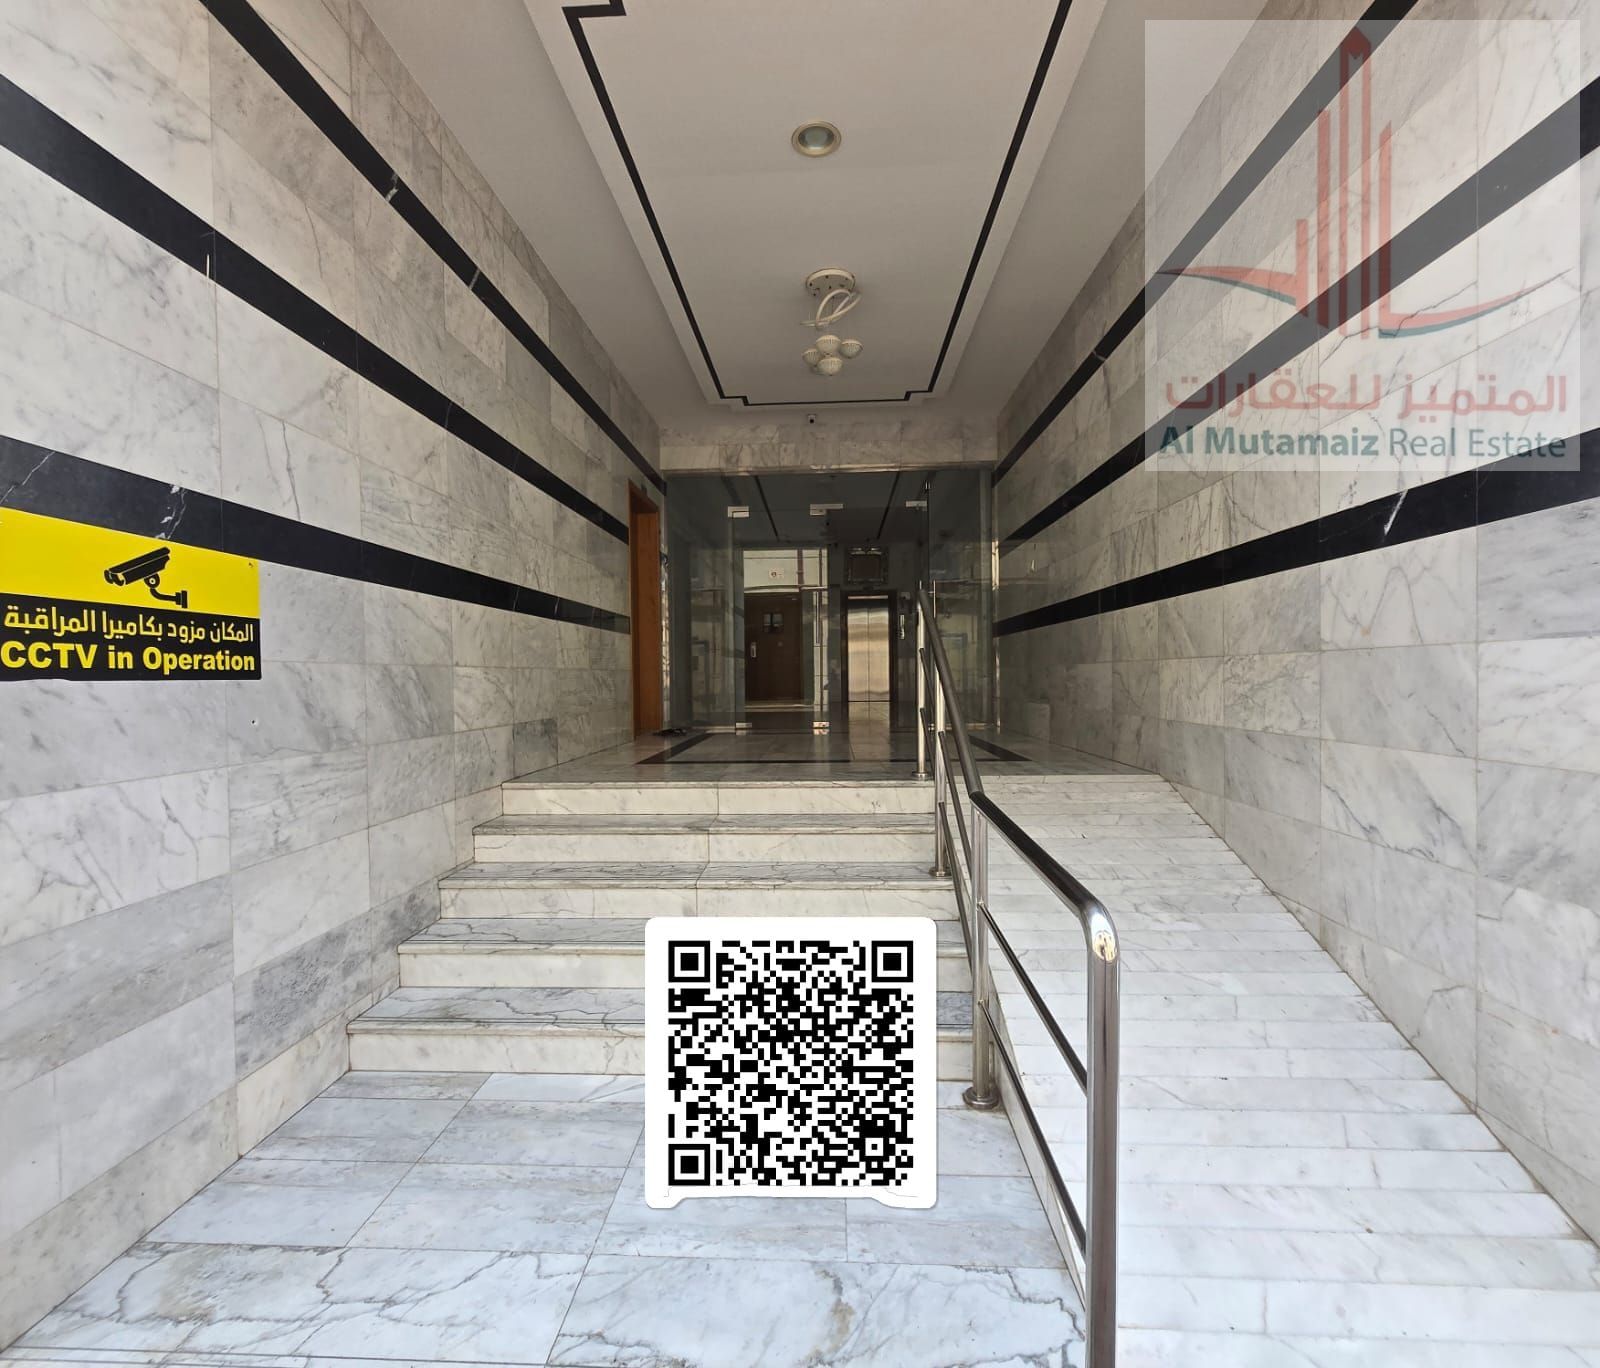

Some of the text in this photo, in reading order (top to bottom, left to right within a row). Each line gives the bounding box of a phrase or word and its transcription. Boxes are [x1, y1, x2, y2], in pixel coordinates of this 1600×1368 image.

[4, 605, 254, 643] المكان مزود بكاميرا المراقبة
[0, 640, 255, 675] CCTV in Operation
